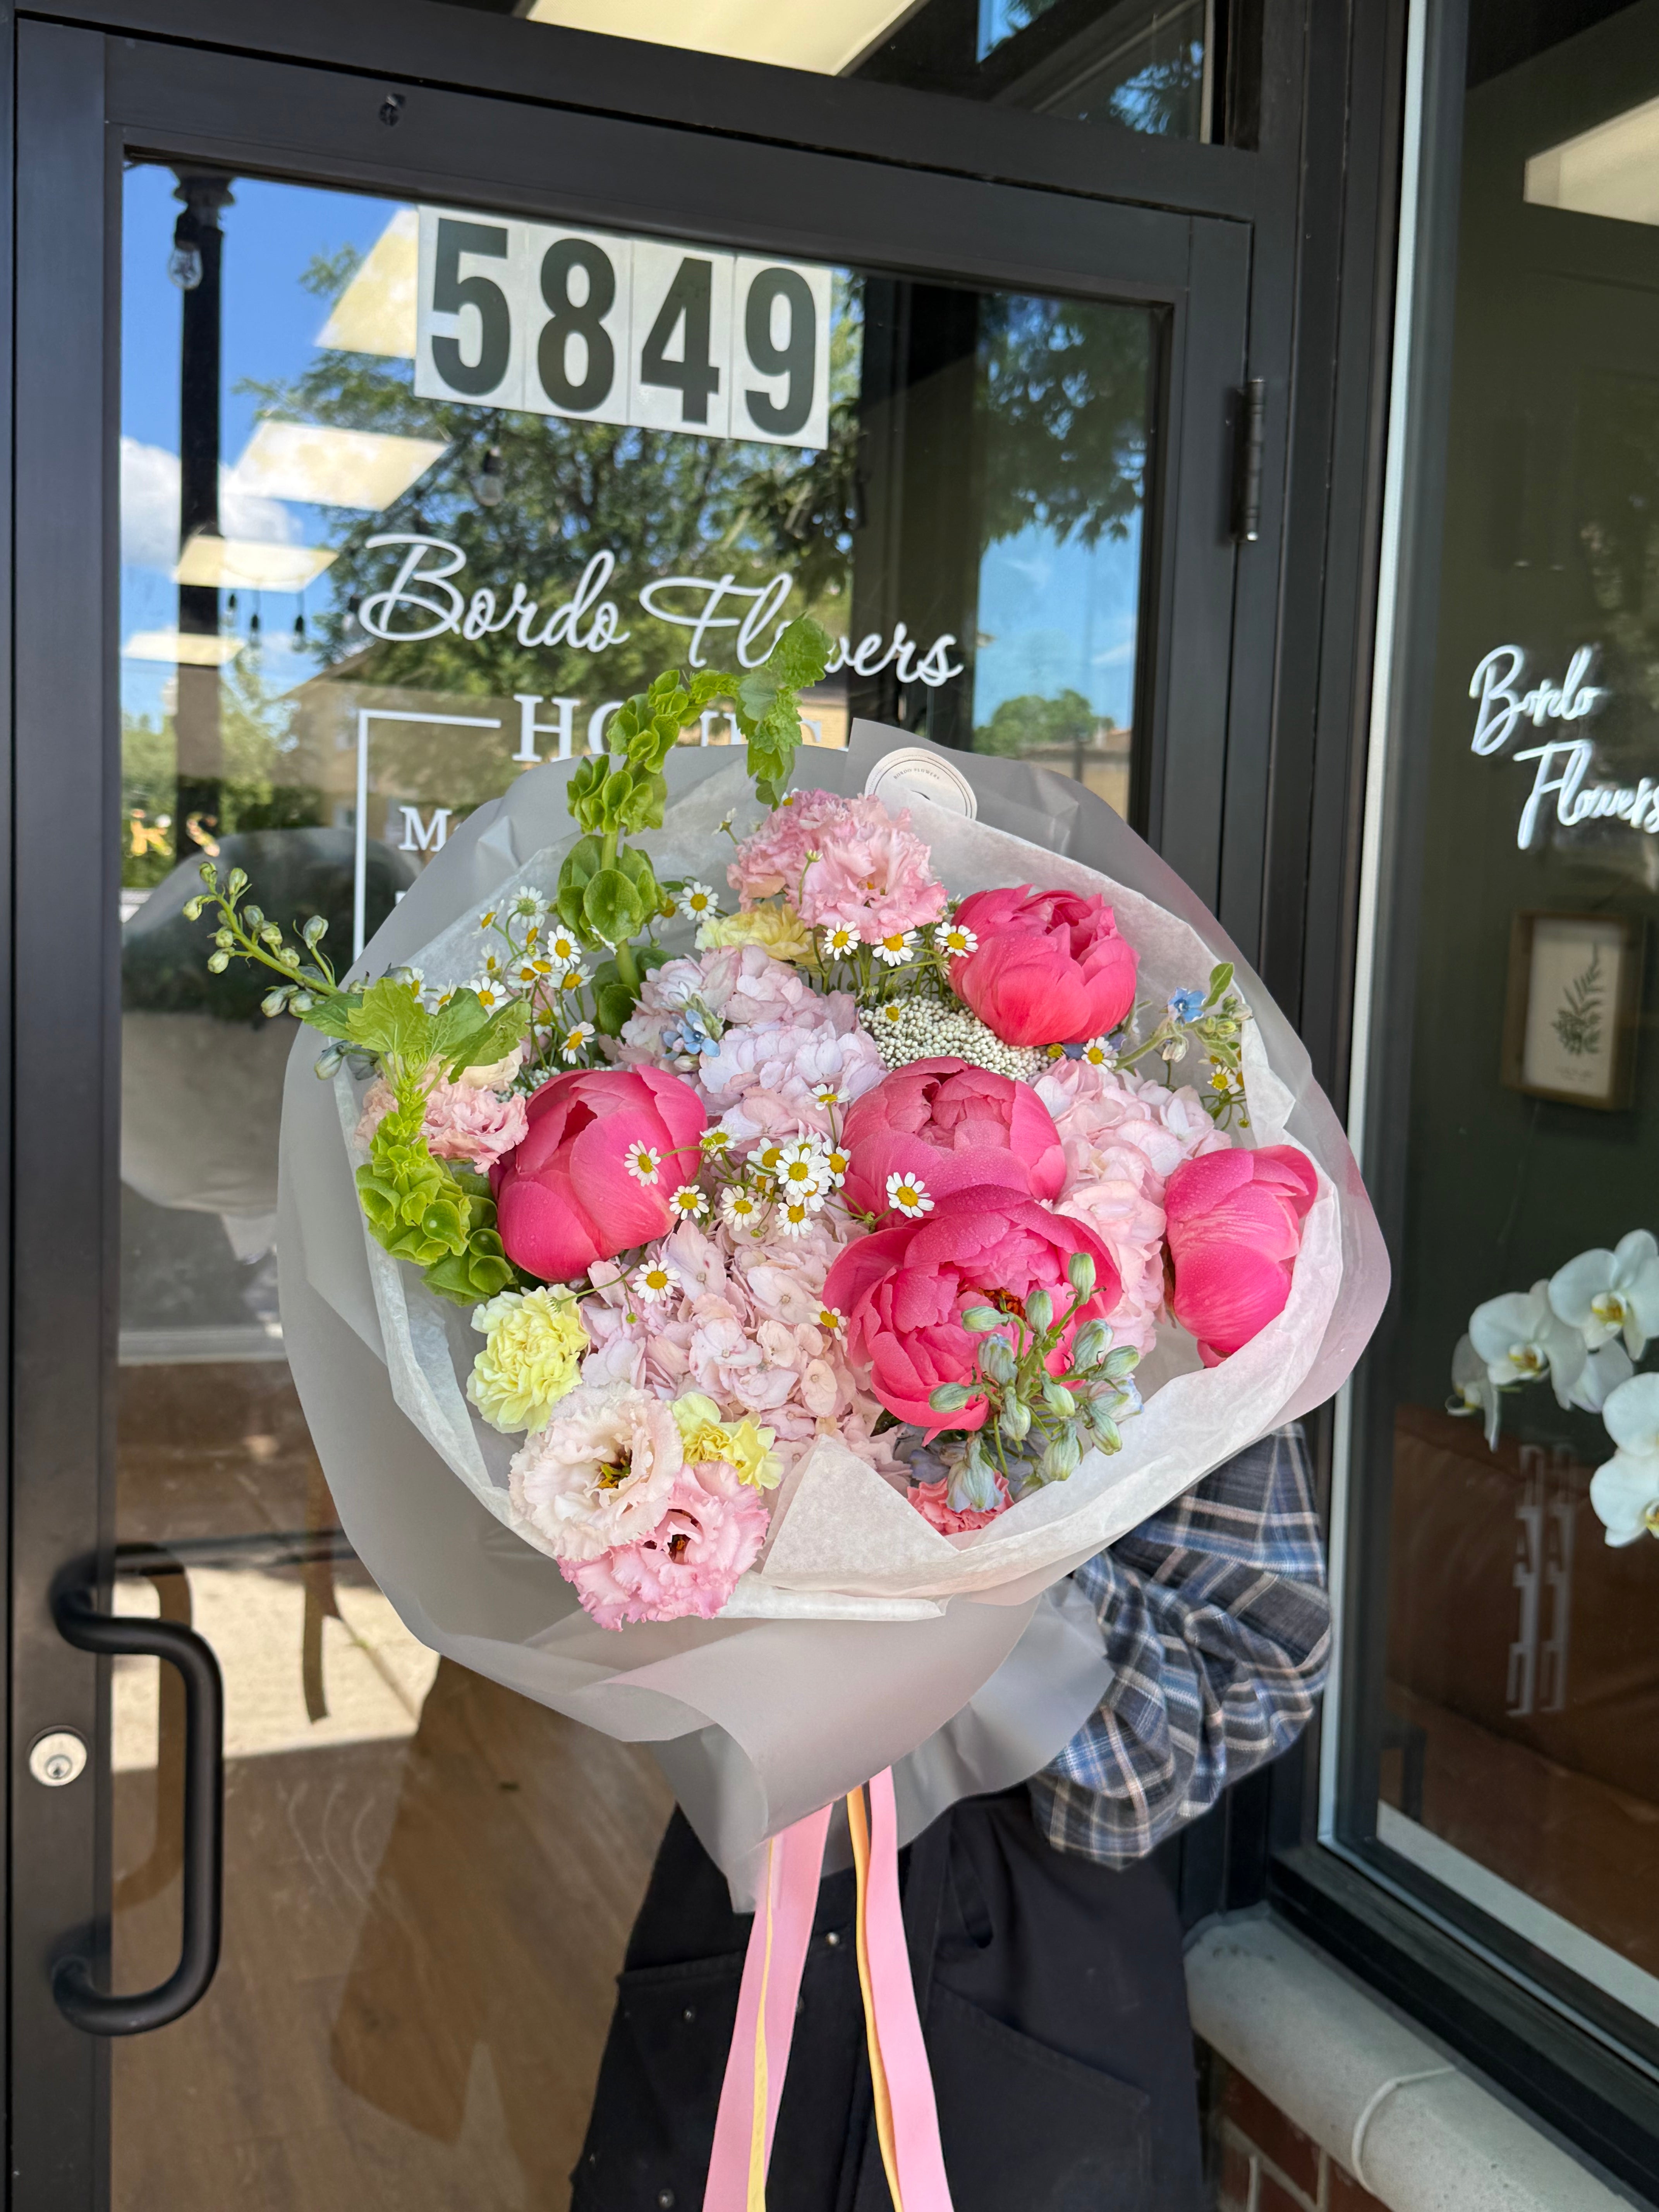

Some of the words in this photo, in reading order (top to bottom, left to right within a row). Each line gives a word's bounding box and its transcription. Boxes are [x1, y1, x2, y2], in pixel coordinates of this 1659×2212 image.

[431, 217, 817, 436] 5849
[359, 534, 630, 653] Bordo
[639, 572, 963, 687] Flwers
[1469, 644, 1606, 756] Bordo
